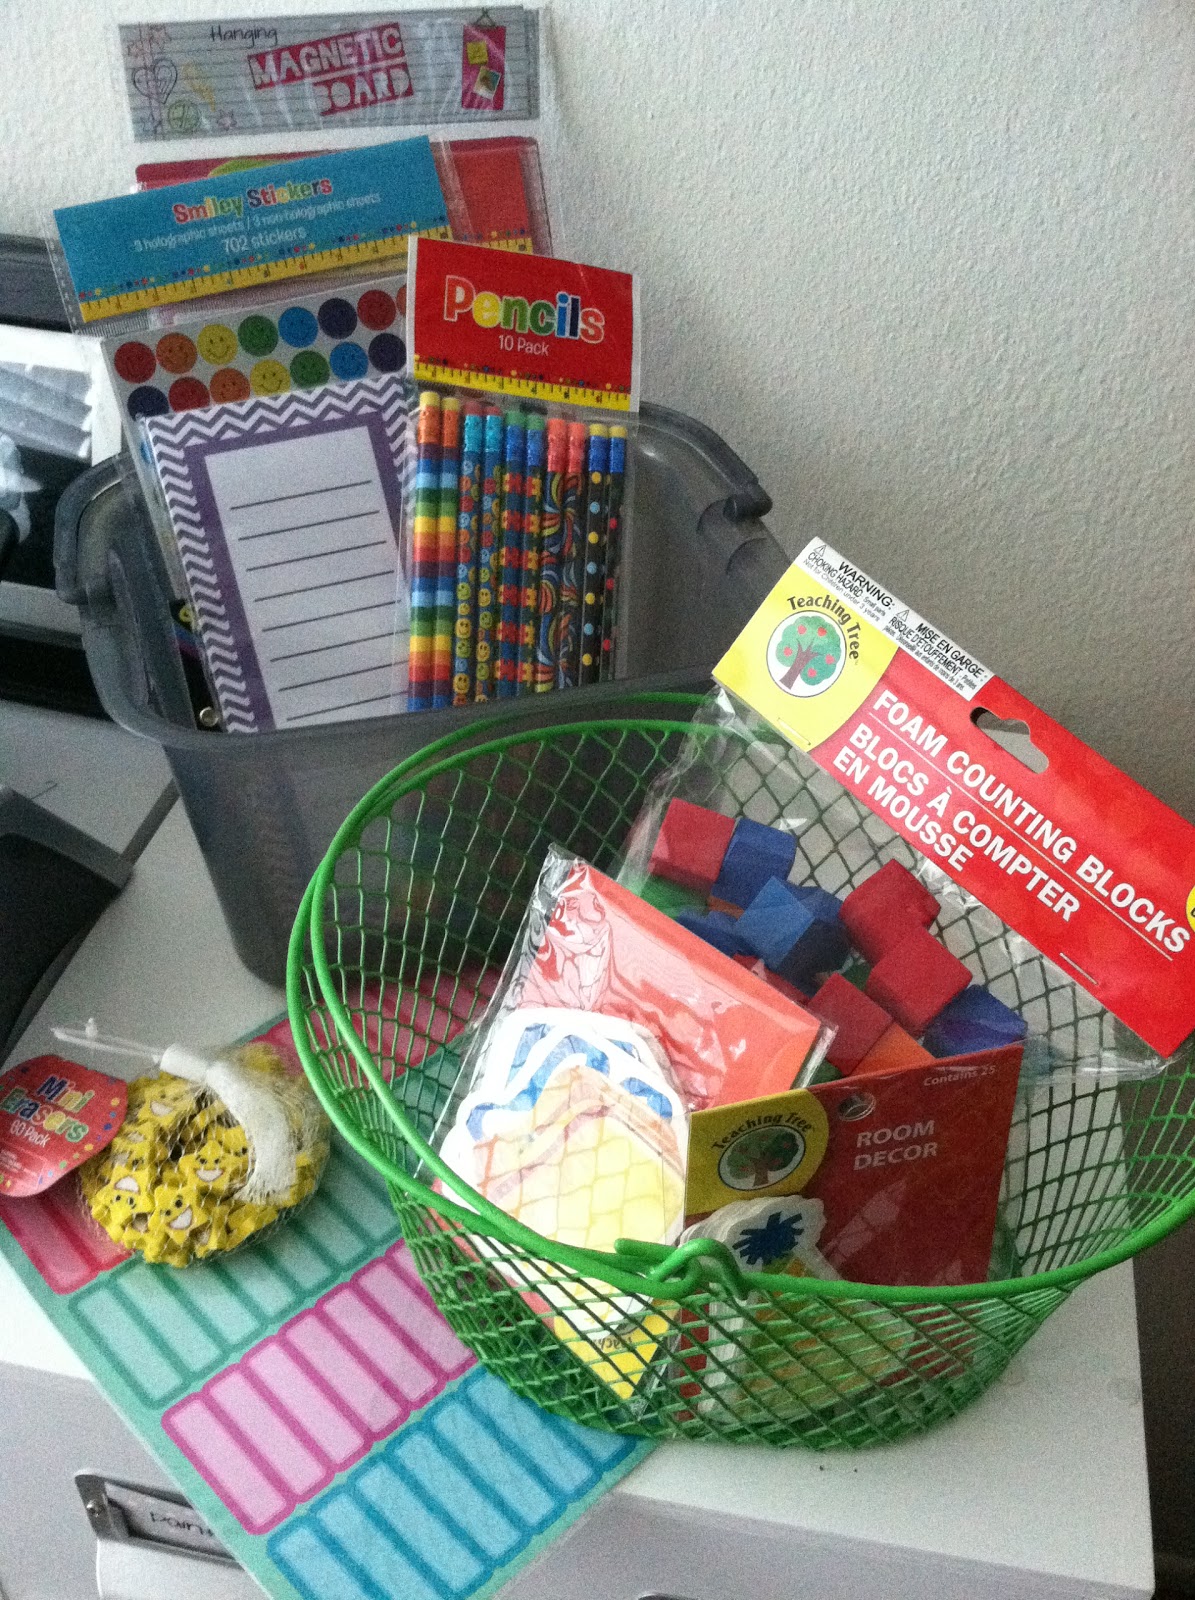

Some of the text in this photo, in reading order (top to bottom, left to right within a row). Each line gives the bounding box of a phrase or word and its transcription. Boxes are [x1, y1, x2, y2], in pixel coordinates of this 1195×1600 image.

[210, 25, 278, 49] Hanging
[249, 27, 402, 86] MAGNETIC
[172, 178, 333, 224] Smiley Stickers
[224, 227, 307, 254] 702 stickers
[443, 274, 605, 344] Pencils
[498, 334, 549, 356] 10 Pack
[806, 551, 838, 578] CHOKING
[834, 573, 863, 598] HAZARD
[836, 561, 897, 610] WARNING:
[787, 595, 862, 660] Teaching Tree
[887, 615, 914, 639] RISQUE
[914, 621, 940, 645] MISE
[936, 638, 952, 654] EN
[833, 745, 974, 872] EN MOUSSE
[849, 723, 1081, 921] BLOCS À COMPTER
[873, 689, 1190, 954] FOAM COUNTING BLOCKS
[36, 1075, 95, 1113] Mini
[923, 1065, 996, 1086] Contains 25
[0, 1087, 90, 1143] Erasers
[711, 1112, 812, 1149] Teaching Tree
[856, 1120, 935, 1148] ROOM
[24, 1125, 50, 1147] Pack
[854, 1142, 938, 1171] DECOR
